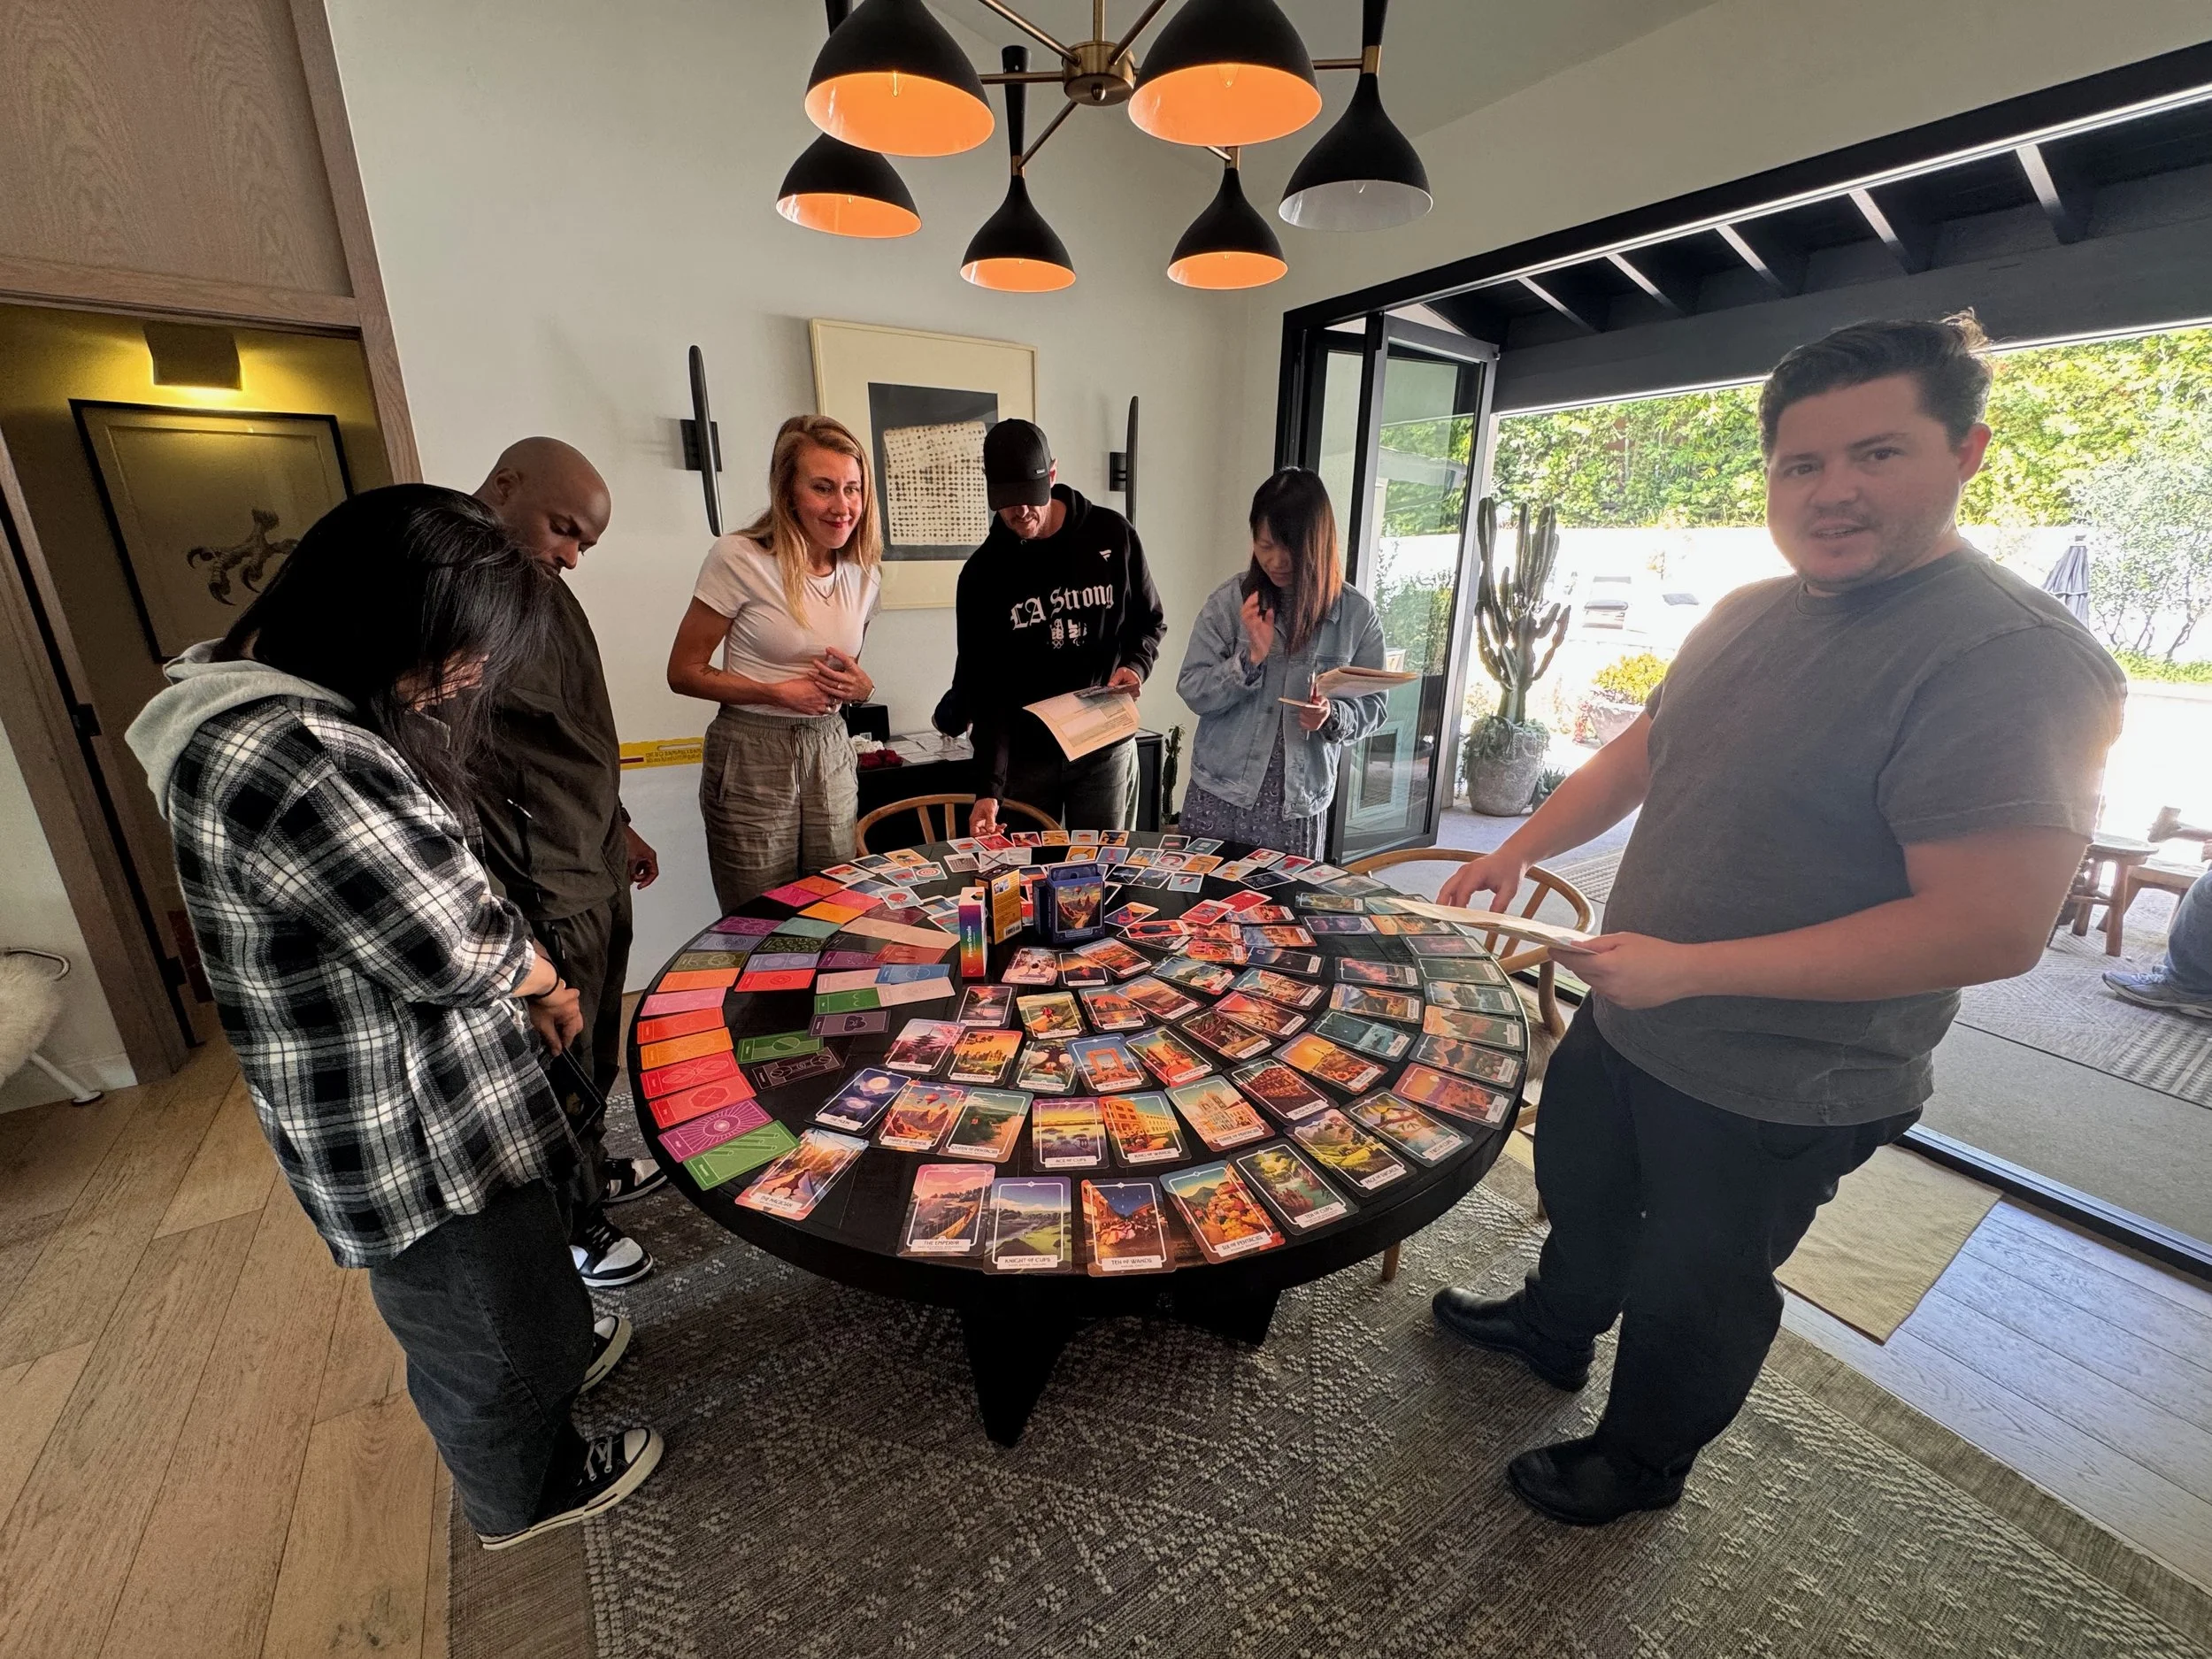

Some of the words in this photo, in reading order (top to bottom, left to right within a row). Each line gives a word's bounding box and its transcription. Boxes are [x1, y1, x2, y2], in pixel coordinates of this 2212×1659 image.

[1010, 596, 1047, 630] LA
[1050, 584, 1114, 618] Strong
[770, 1197, 793, 1207] MAGICIAN
[1236, 1234, 1263, 1248] PENTACLES
